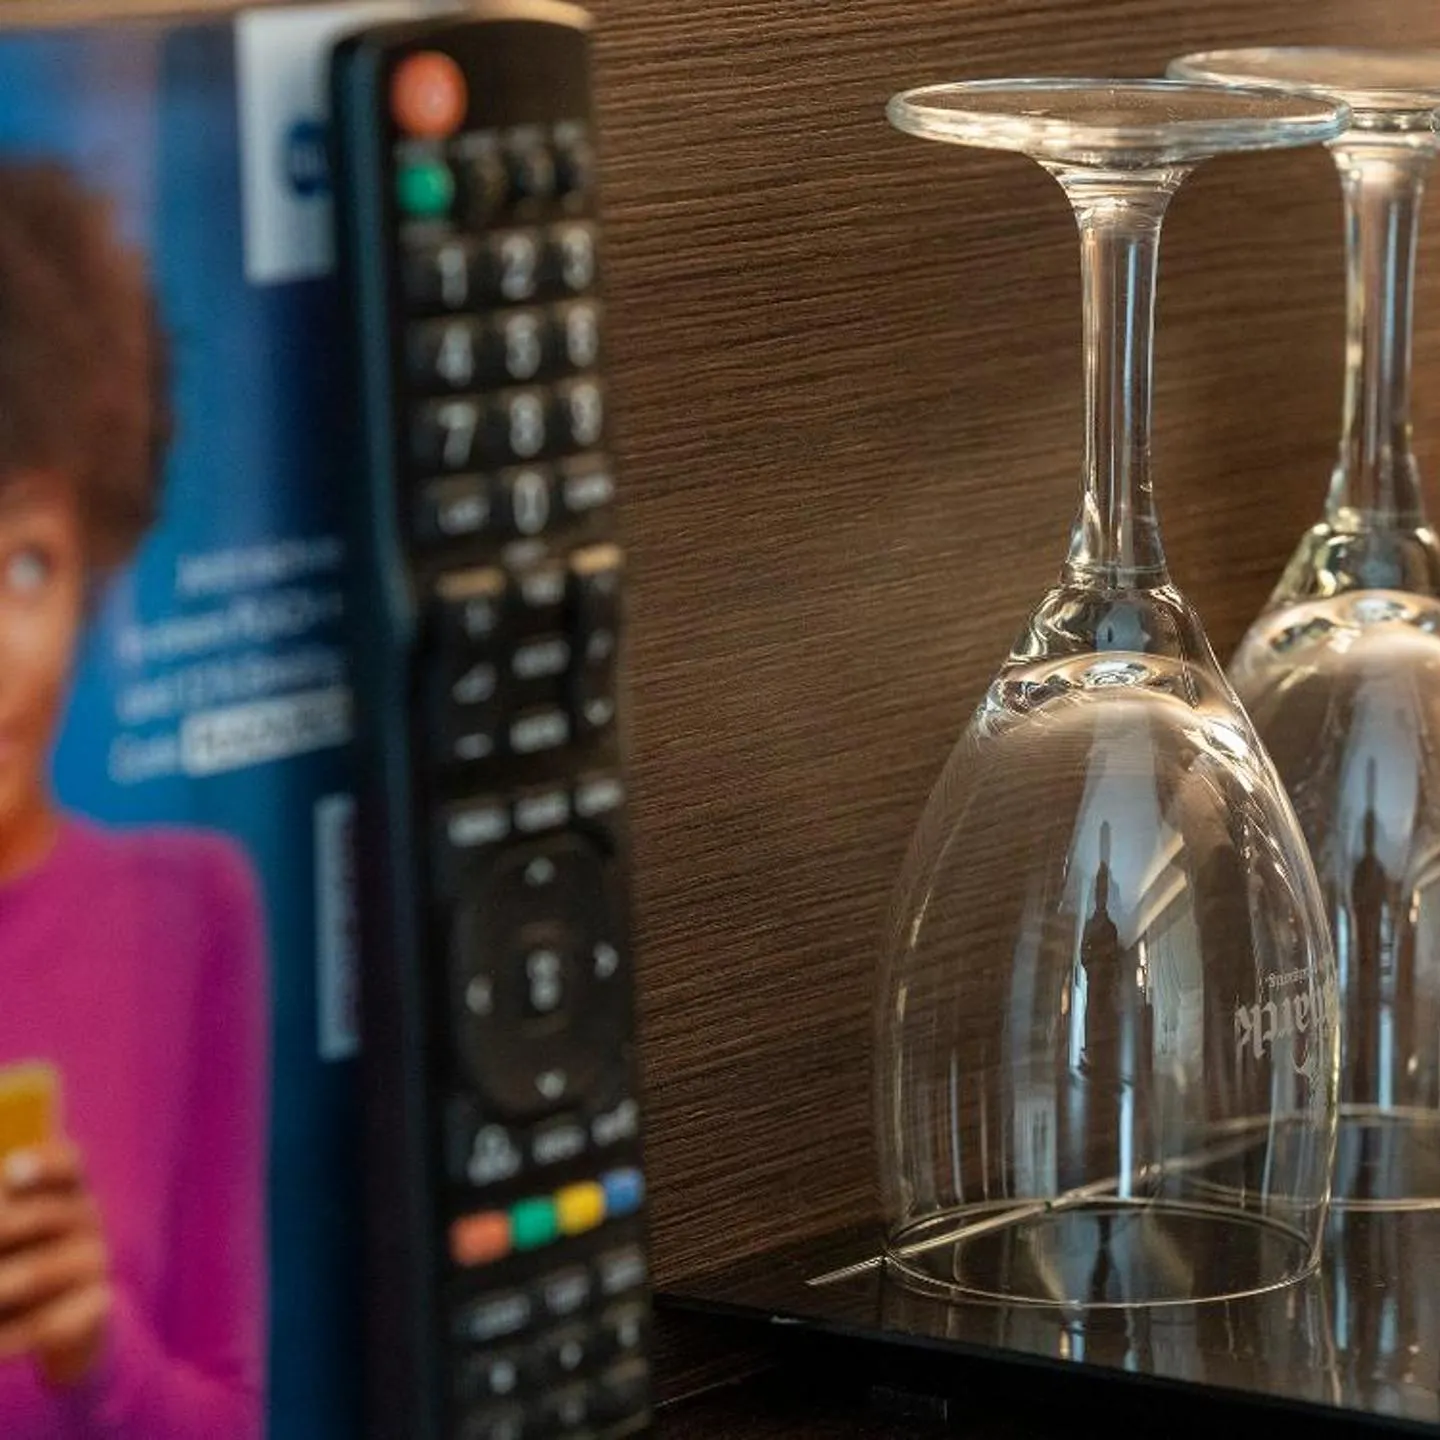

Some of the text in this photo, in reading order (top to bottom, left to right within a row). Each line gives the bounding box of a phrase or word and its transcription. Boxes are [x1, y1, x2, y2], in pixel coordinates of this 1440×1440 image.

[501, 233, 537, 300] 2
[562, 227, 594, 290] 3
[436, 322, 474, 387] 4
[505, 313, 542, 379] 5
[437, 384, 602, 468] 7 8 9
